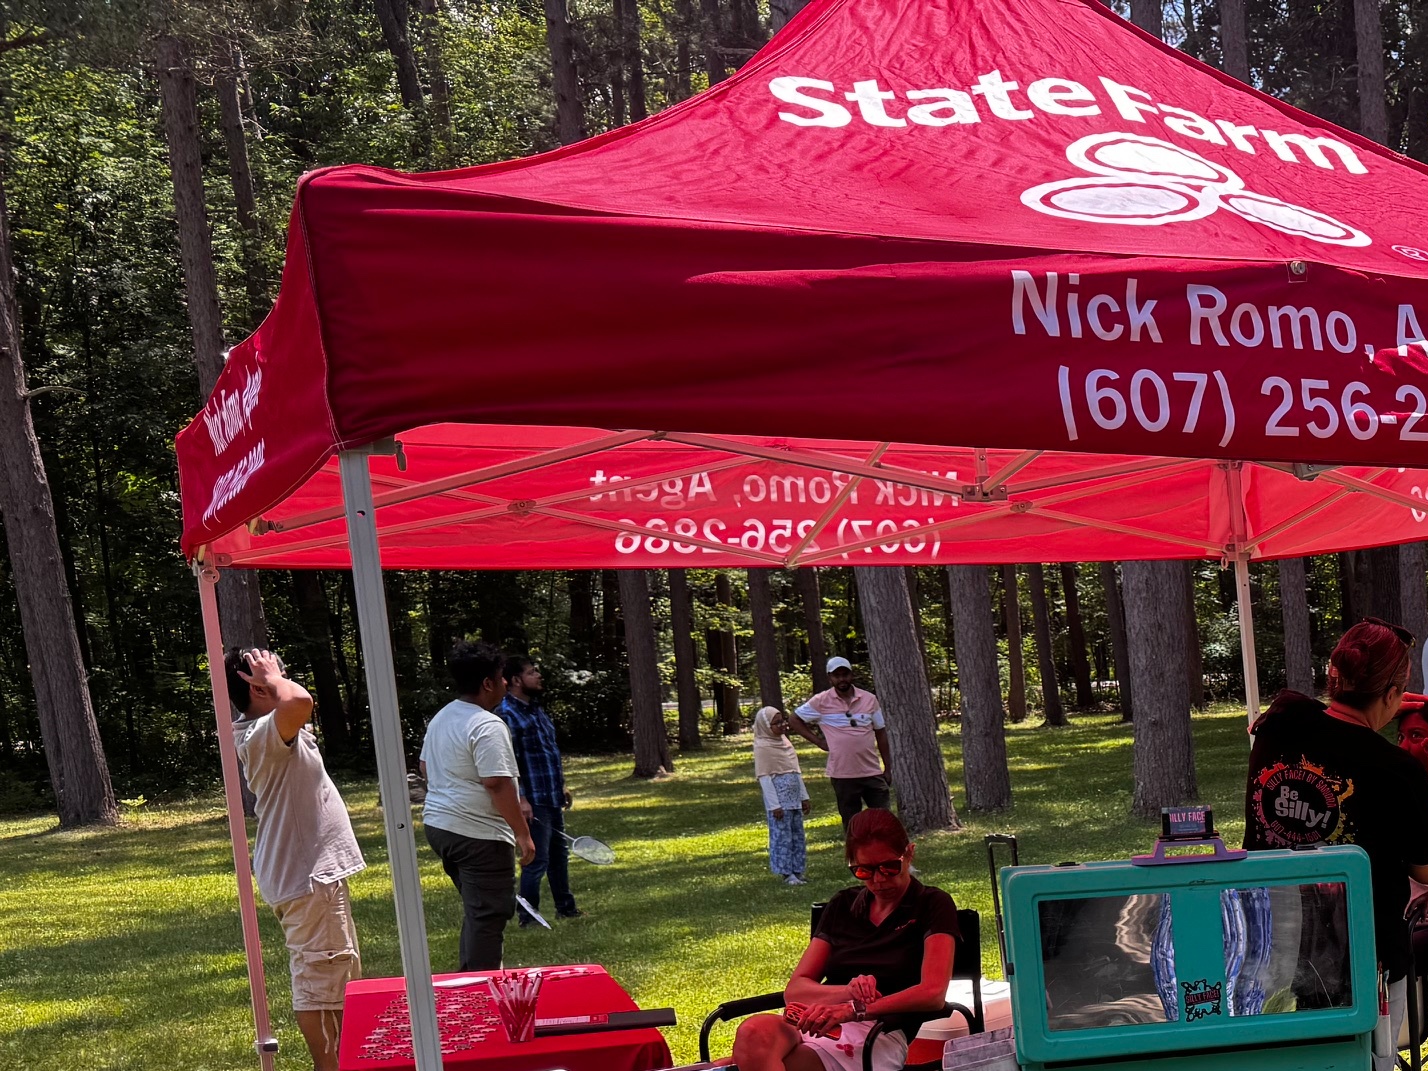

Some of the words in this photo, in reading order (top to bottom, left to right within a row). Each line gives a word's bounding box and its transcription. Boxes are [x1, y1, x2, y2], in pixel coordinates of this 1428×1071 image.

[1011, 270, 1163, 343] Nick
[1187, 284, 1374, 363] Romo,
[1058, 365, 1235, 447] (607)
[1266, 773, 1283, 791] SILLY
[1280, 785, 1299, 800] Be
[1275, 797, 1332, 829] Silly!
